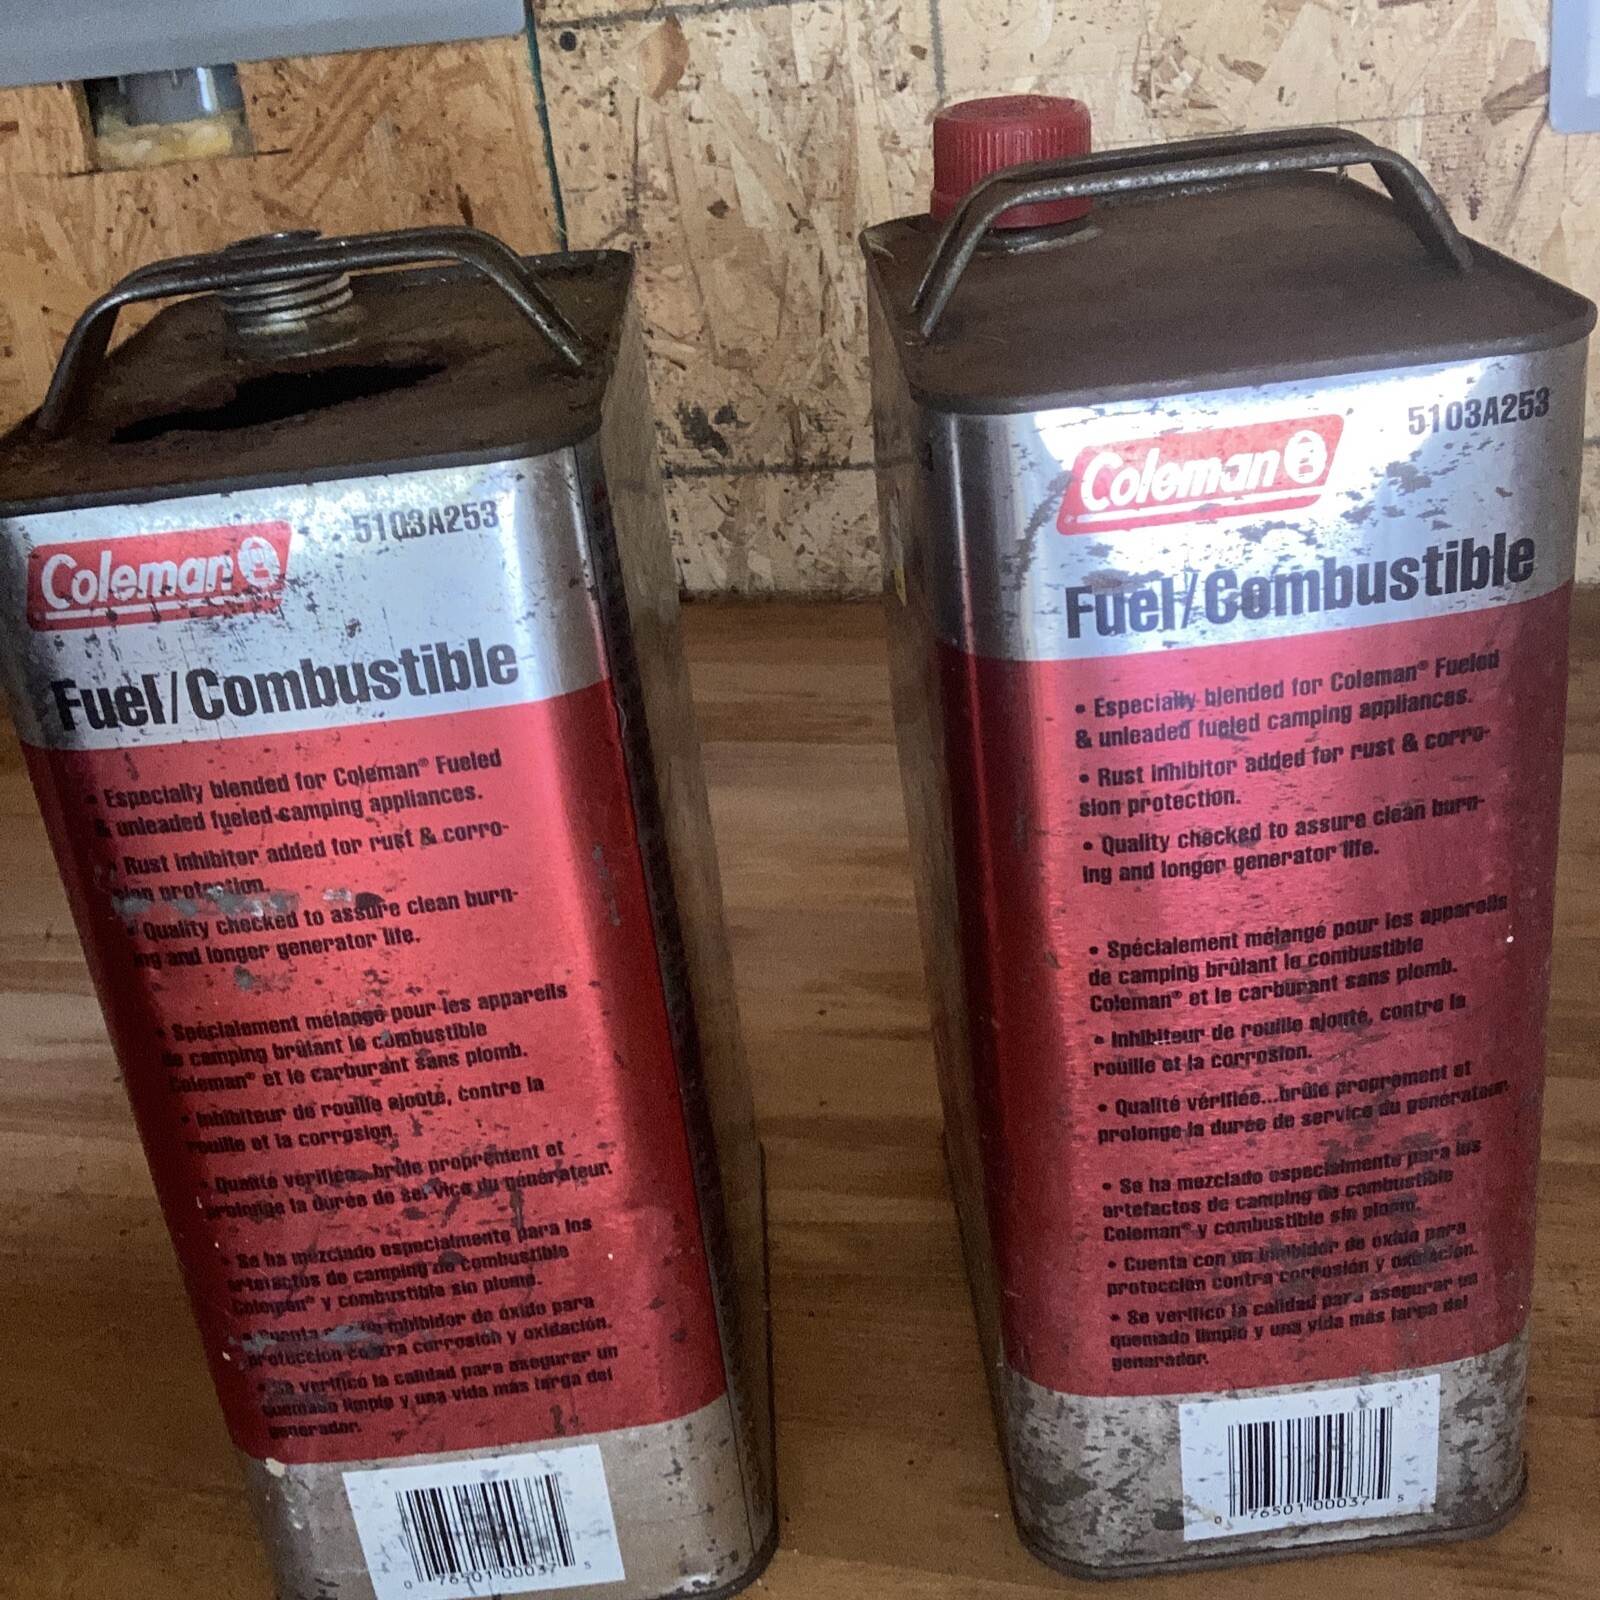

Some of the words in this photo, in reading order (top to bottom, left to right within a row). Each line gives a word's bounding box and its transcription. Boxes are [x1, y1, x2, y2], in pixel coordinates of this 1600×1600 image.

[1079, 447, 1276, 509] Coleman
[1408, 387, 1549, 436] 5103A253
[40, 550, 232, 604] Coleman
[352, 500, 500, 544] 5103A253
[1065, 533, 1535, 639] Fuel/Combustible
[50, 638, 518, 731] Fuel/Combustible
[1094, 691, 1196, 718] Especially
[1205, 678, 1283, 707] blended
[1292, 678, 1322, 696] for
[1436, 650, 1499, 678] Fueled
[1076, 729, 1092, 749] &
[1100, 721, 1190, 747] unleaded
[1199, 713, 1259, 738] fueled
[1268, 705, 1352, 730] camping
[1359, 689, 1473, 720] appliances.
[1098, 767, 1144, 787] Rust
[1151, 759, 1237, 783] inhibitor
[1246, 749, 1305, 773] added
[1313, 746, 1343, 764] for
[1351, 738, 1395, 759] rust
[1402, 733, 1419, 752] &
[1425, 726, 1490, 749] corro-
[103, 783, 203, 809] Especially
[210, 774, 290, 799] blended
[295, 771, 327, 791] for
[436, 749, 502, 775] Fueled
[117, 812, 205, 837] unleaded
[211, 806, 272, 830] fueled
[279, 797, 364, 821] camping
[370, 785, 482, 814] appliances.
[1079, 798, 1121, 817] sion
[1128, 789, 1240, 817] protection.
[123, 856, 170, 875] Rust
[175, 848, 259, 871] inhibitor
[267, 840, 326, 863] added
[331, 838, 362, 855] for
[370, 829, 413, 851] rust
[420, 827, 436, 846] &
[443, 821, 508, 843] corro-
[1102, 833, 1170, 856] Quality
[1178, 823, 1261, 849] checked
[1269, 821, 1287, 839] to
[1295, 812, 1365, 836] assure
[1373, 805, 1425, 825] clean
[1083, 865, 1112, 884] ing
[1120, 862, 1154, 882] and
[1162, 858, 1226, 879] longer
[1234, 846, 1336, 874] generator
[1343, 839, 1379, 858] life.
[143, 921, 209, 942] Quality
[216, 911, 298, 935] checked
[304, 910, 324, 926] to
[331, 902, 400, 922] assure
[407, 895, 460, 915] clean
[464, 887, 518, 908] burn-
[1333, 917, 1379, 940] pour
[1385, 913, 1413, 931] les
[168, 947, 201, 966] and
[206, 944, 269, 964] longer
[276, 933, 377, 959] generator
[383, 928, 420, 946] life.
[1089, 969, 1111, 987] de
[1119, 964, 1199, 985] camping
[1284, 953, 1301, 970] le
[1308, 937, 1423, 968] combustible
[1189, 988, 1208, 1006] et
[1215, 987, 1232, 1004] le
[1239, 975, 1339, 1002] carburant
[1345, 968, 1390, 990] sans
[1396, 958, 1457, 985] plomb.
[391, 1003, 436, 1023] pour
[443, 998, 471, 1015] les
[478, 983, 567, 1010] appareils
[1112, 1027, 1205, 1048] Inhibiteur
[1212, 1023, 1234, 1041] de
[1241, 1016, 1303, 1039] rouille
[1381, 998, 1443, 1021] contre
[1450, 993, 1466, 1010] la
[349, 1035, 367, 1052] le
[372, 1022, 487, 1049] combustible
[263, 1070, 283, 1087] et
[288, 1069, 305, 1085] le
[310, 1057, 409, 1082] carburant
[416, 1052, 459, 1071] sans
[465, 1042, 527, 1066] plomb.
[1093, 1057, 1156, 1076] rouille
[1162, 1056, 1181, 1073] et
[1188, 1054, 1204, 1072] la
[1211, 1044, 1312, 1069] corrosion.
[1336, 1065, 1447, 1098] proprement
[1454, 1060, 1471, 1077] et
[293, 1104, 316, 1121] de
[458, 1081, 521, 1102] contre
[526, 1076, 544, 1092] la
[1098, 1124, 1181, 1144] prolonge
[1187, 1121, 1204, 1138] la
[1273, 1113, 1294, 1130] de
[1301, 1104, 1373, 1127] service
[1379, 1099, 1400, 1116] du
[252, 1135, 269, 1151] et
[275, 1134, 292, 1149] la
[546, 1141, 564, 1157] et
[1120, 1178, 1143, 1194] Se
[1150, 1177, 1171, 1192] ha
[1177, 1170, 1263, 1190] mezclado
[1102, 1200, 1201, 1219] artefactos
[1207, 1197, 1229, 1213] de
[1235, 1190, 1312, 1211] camping
[1214, 1210, 1324, 1236] combustible
[1331, 1207, 1357, 1224] sin
[518, 1221, 560, 1243] para
[565, 1218, 592, 1233] los
[1125, 1256, 1187, 1271] Cuenta
[1193, 1253, 1226, 1268] con
[1212, 1269, 1273, 1290] contra
[552, 1295, 594, 1315] para
[1128, 1310, 1149, 1325] Se
[1232, 1303, 1247, 1318] la
[1253, 1293, 1316, 1316] calidad
[1307, 1314, 1343, 1332] vida
[1443, 1295, 1468, 1312] del
[452, 1385, 488, 1401] vida
[535, 1373, 581, 1390] larga
[587, 1367, 613, 1384] del
[1214, 1516, 1222, 1524] 0
[1251, 1504, 1304, 1520] 76501
[1313, 1496, 1370, 1511] 00037
[404, 1580, 413, 1589] 0
[437, 1570, 492, 1585] 76501
[501, 1563, 557, 1579] 00037
[585, 1561, 591, 1570] 5
